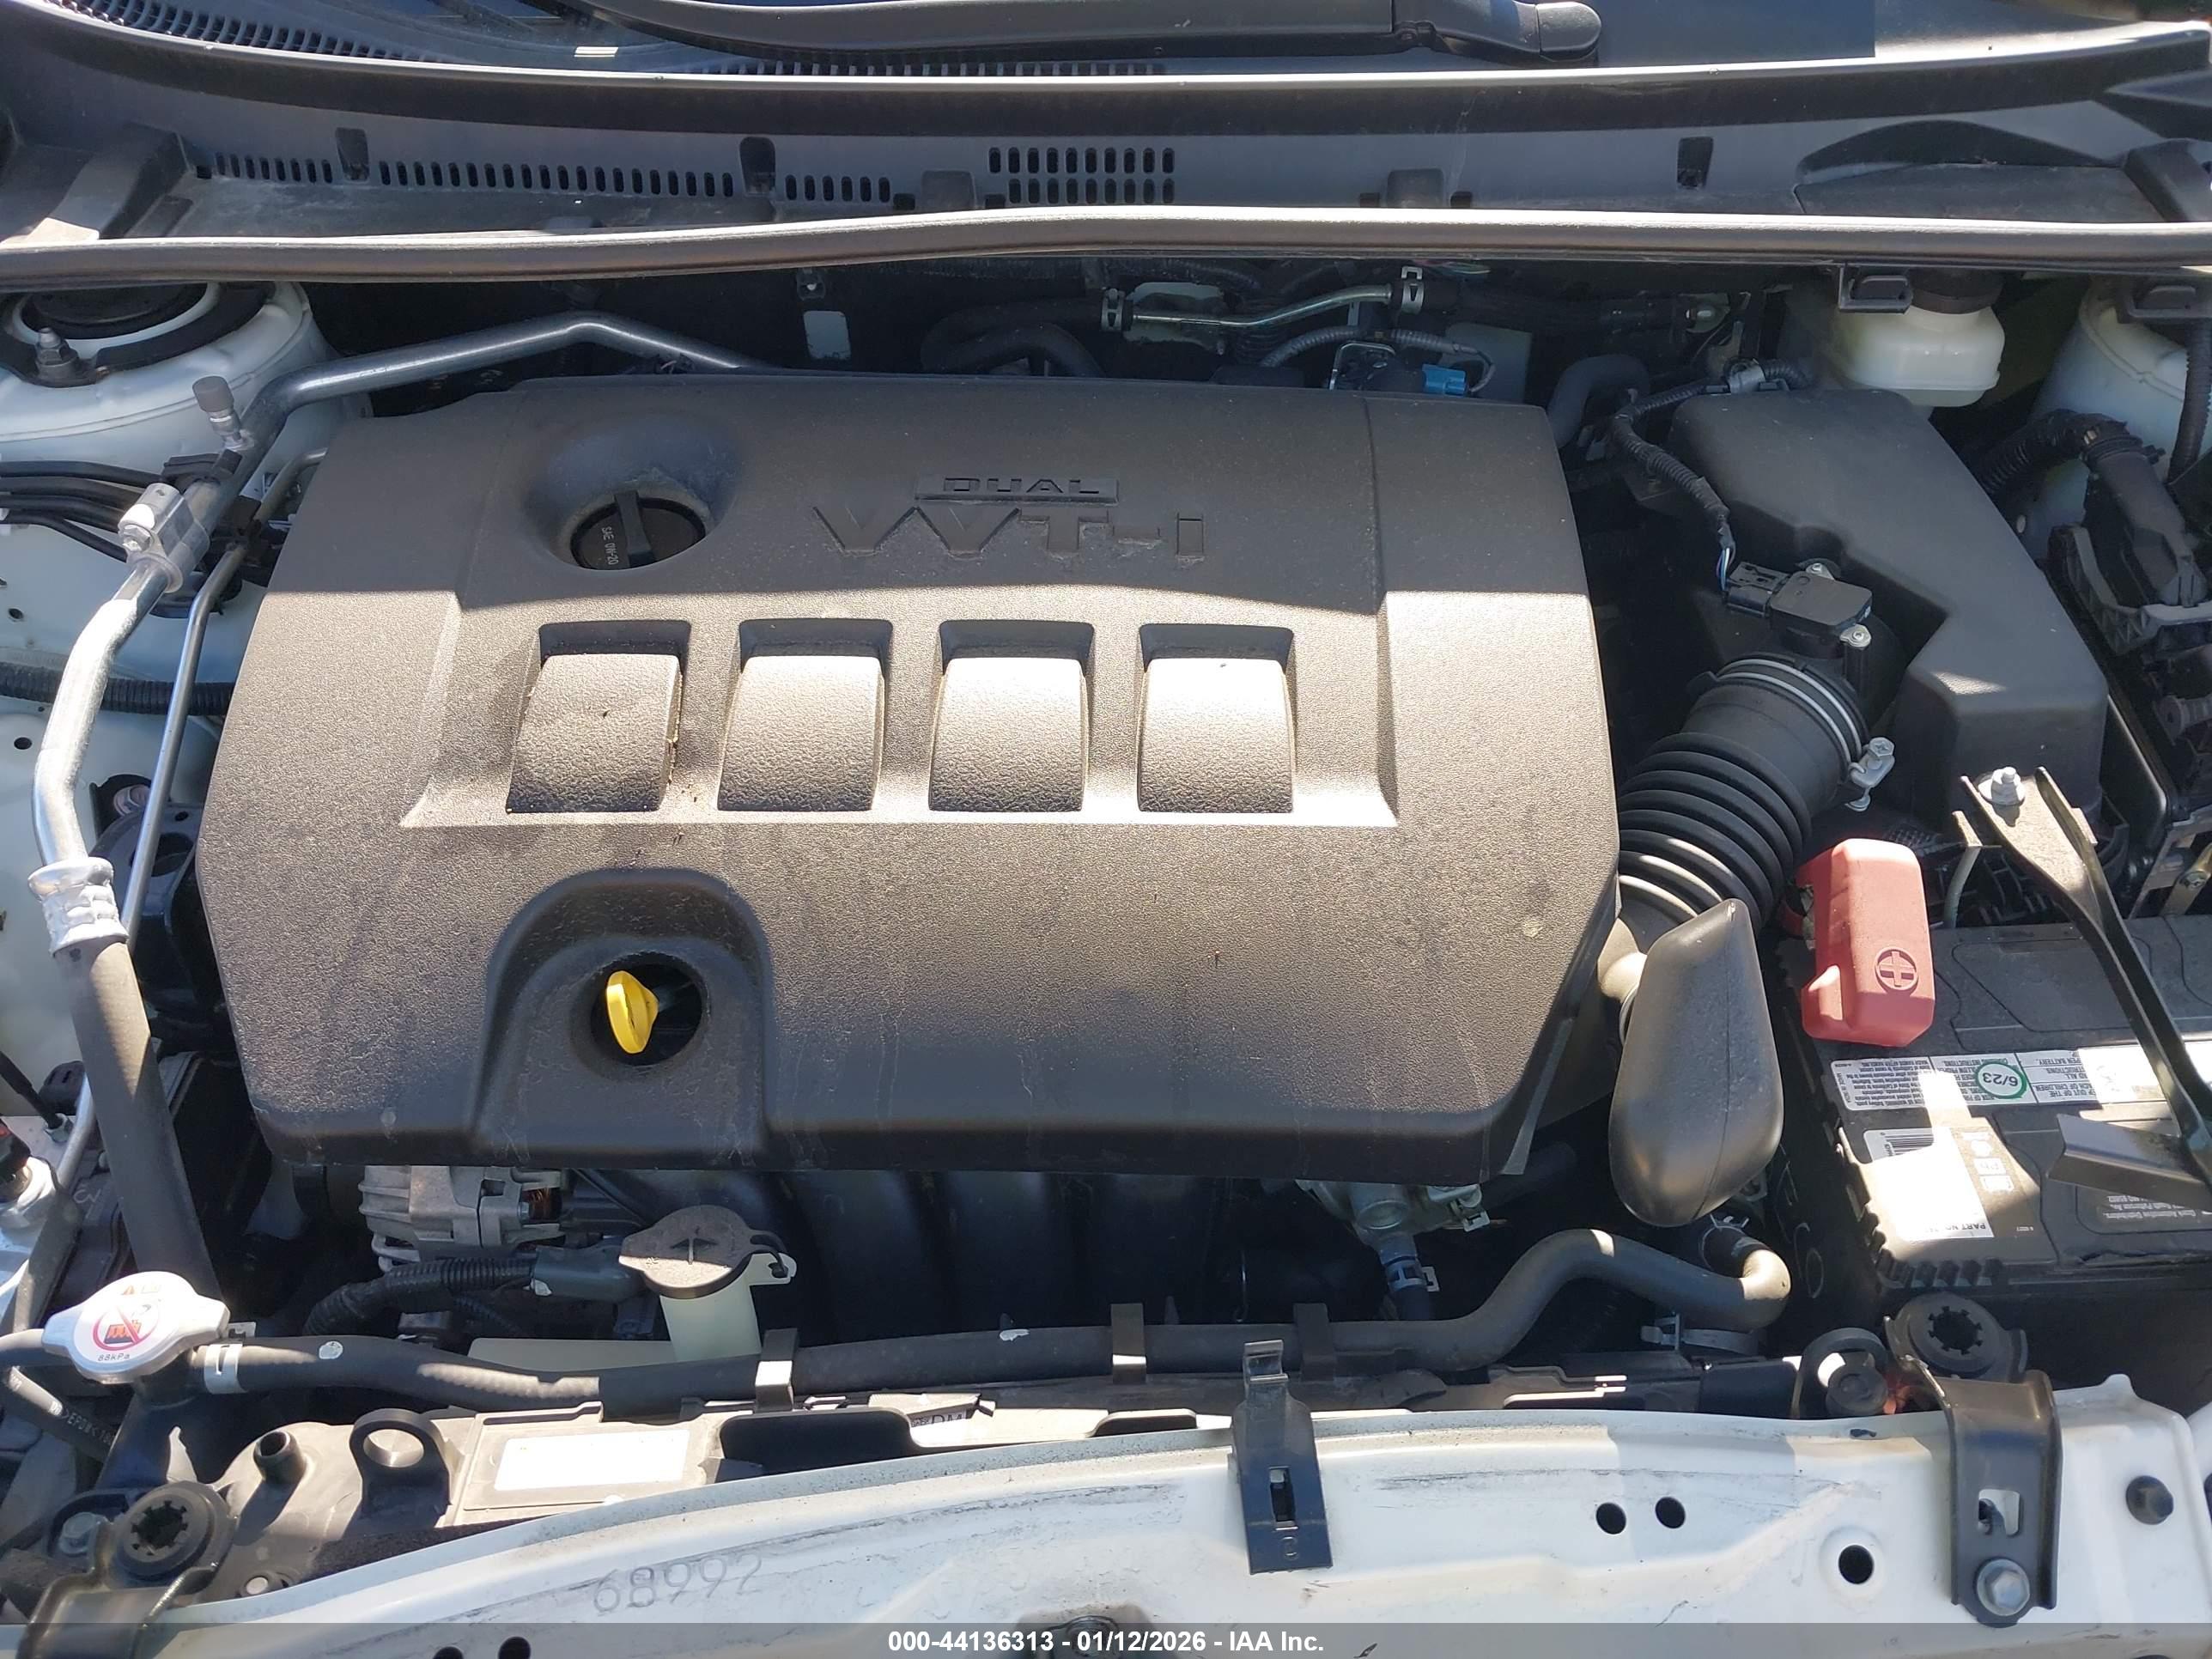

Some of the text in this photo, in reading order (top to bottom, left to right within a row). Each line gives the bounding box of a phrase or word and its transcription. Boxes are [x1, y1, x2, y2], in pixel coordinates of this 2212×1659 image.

[945, 477, 1100, 495] DUAL
[601, 526, 619, 565] SAE 0W-20
[1982, 1072, 2019, 1087] 6/23
[97, 1352, 131, 1362] 88kPa
[593, 1552, 763, 1613] 68992
